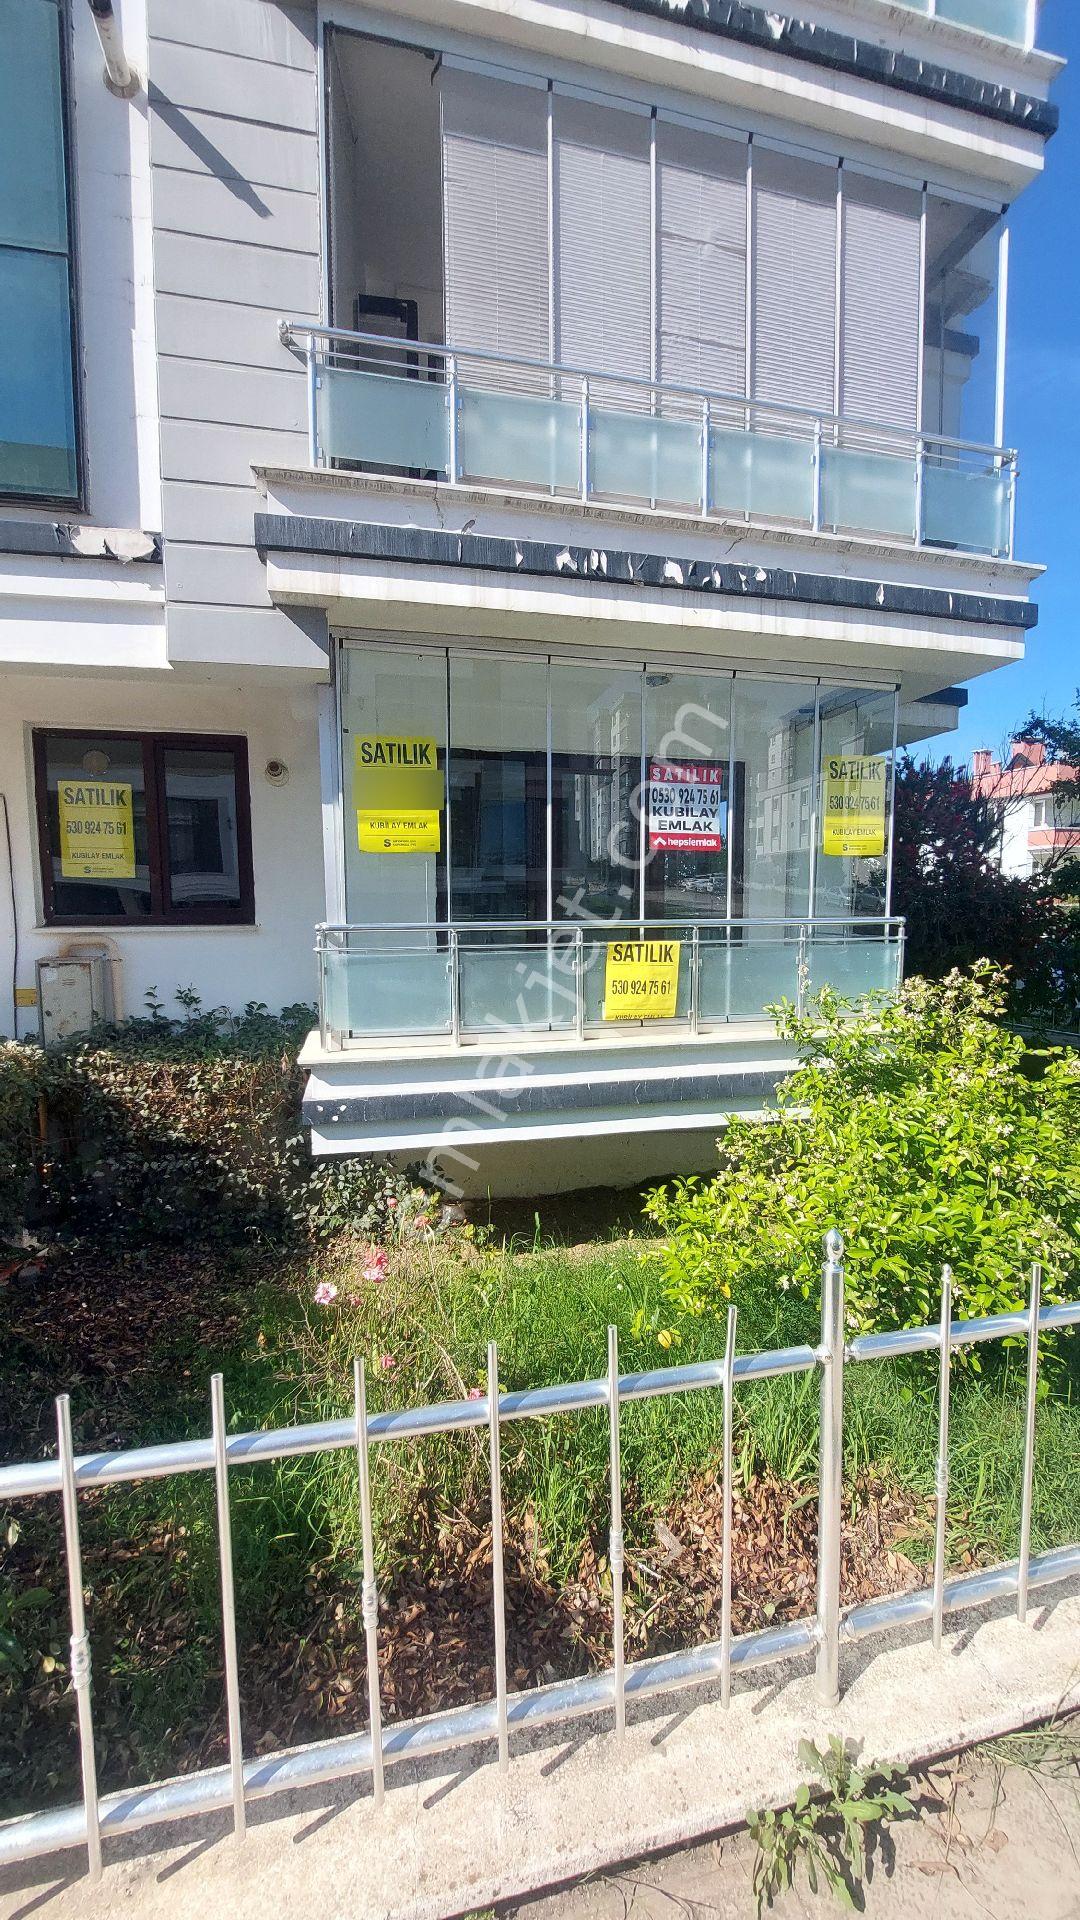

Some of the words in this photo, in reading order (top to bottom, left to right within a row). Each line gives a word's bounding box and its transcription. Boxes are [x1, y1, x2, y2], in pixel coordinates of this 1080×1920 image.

[361, 742, 431, 764] SATILIK
[652, 767, 719, 782] SATILIK
[829, 760, 881, 780] SATILIK
[64, 787, 127, 806] SATILIK
[652, 787, 675, 804] 0530
[679, 788, 695, 804] 924
[697, 789, 707, 804] 75
[710, 790, 719, 805] 61
[829, 796, 843, 810] 530
[845, 796, 860, 810] 924
[860, 796, 869, 810] 75
[870, 796, 880, 810] 61
[66, 820, 82, 834] 530
[84, 821, 100, 835] 924
[104, 821, 113, 835] 75
[116, 822, 126, 835] 61
[658, 819, 713, 831] EMLAK
[668, 837, 717, 847] hepsiemlak
[612, 943, 674, 963] SATILIK
[611, 980, 629, 995] 530
[631, 980, 647, 995] 924
[649, 980, 659, 995] 75
[661, 980, 671, 995] 61
